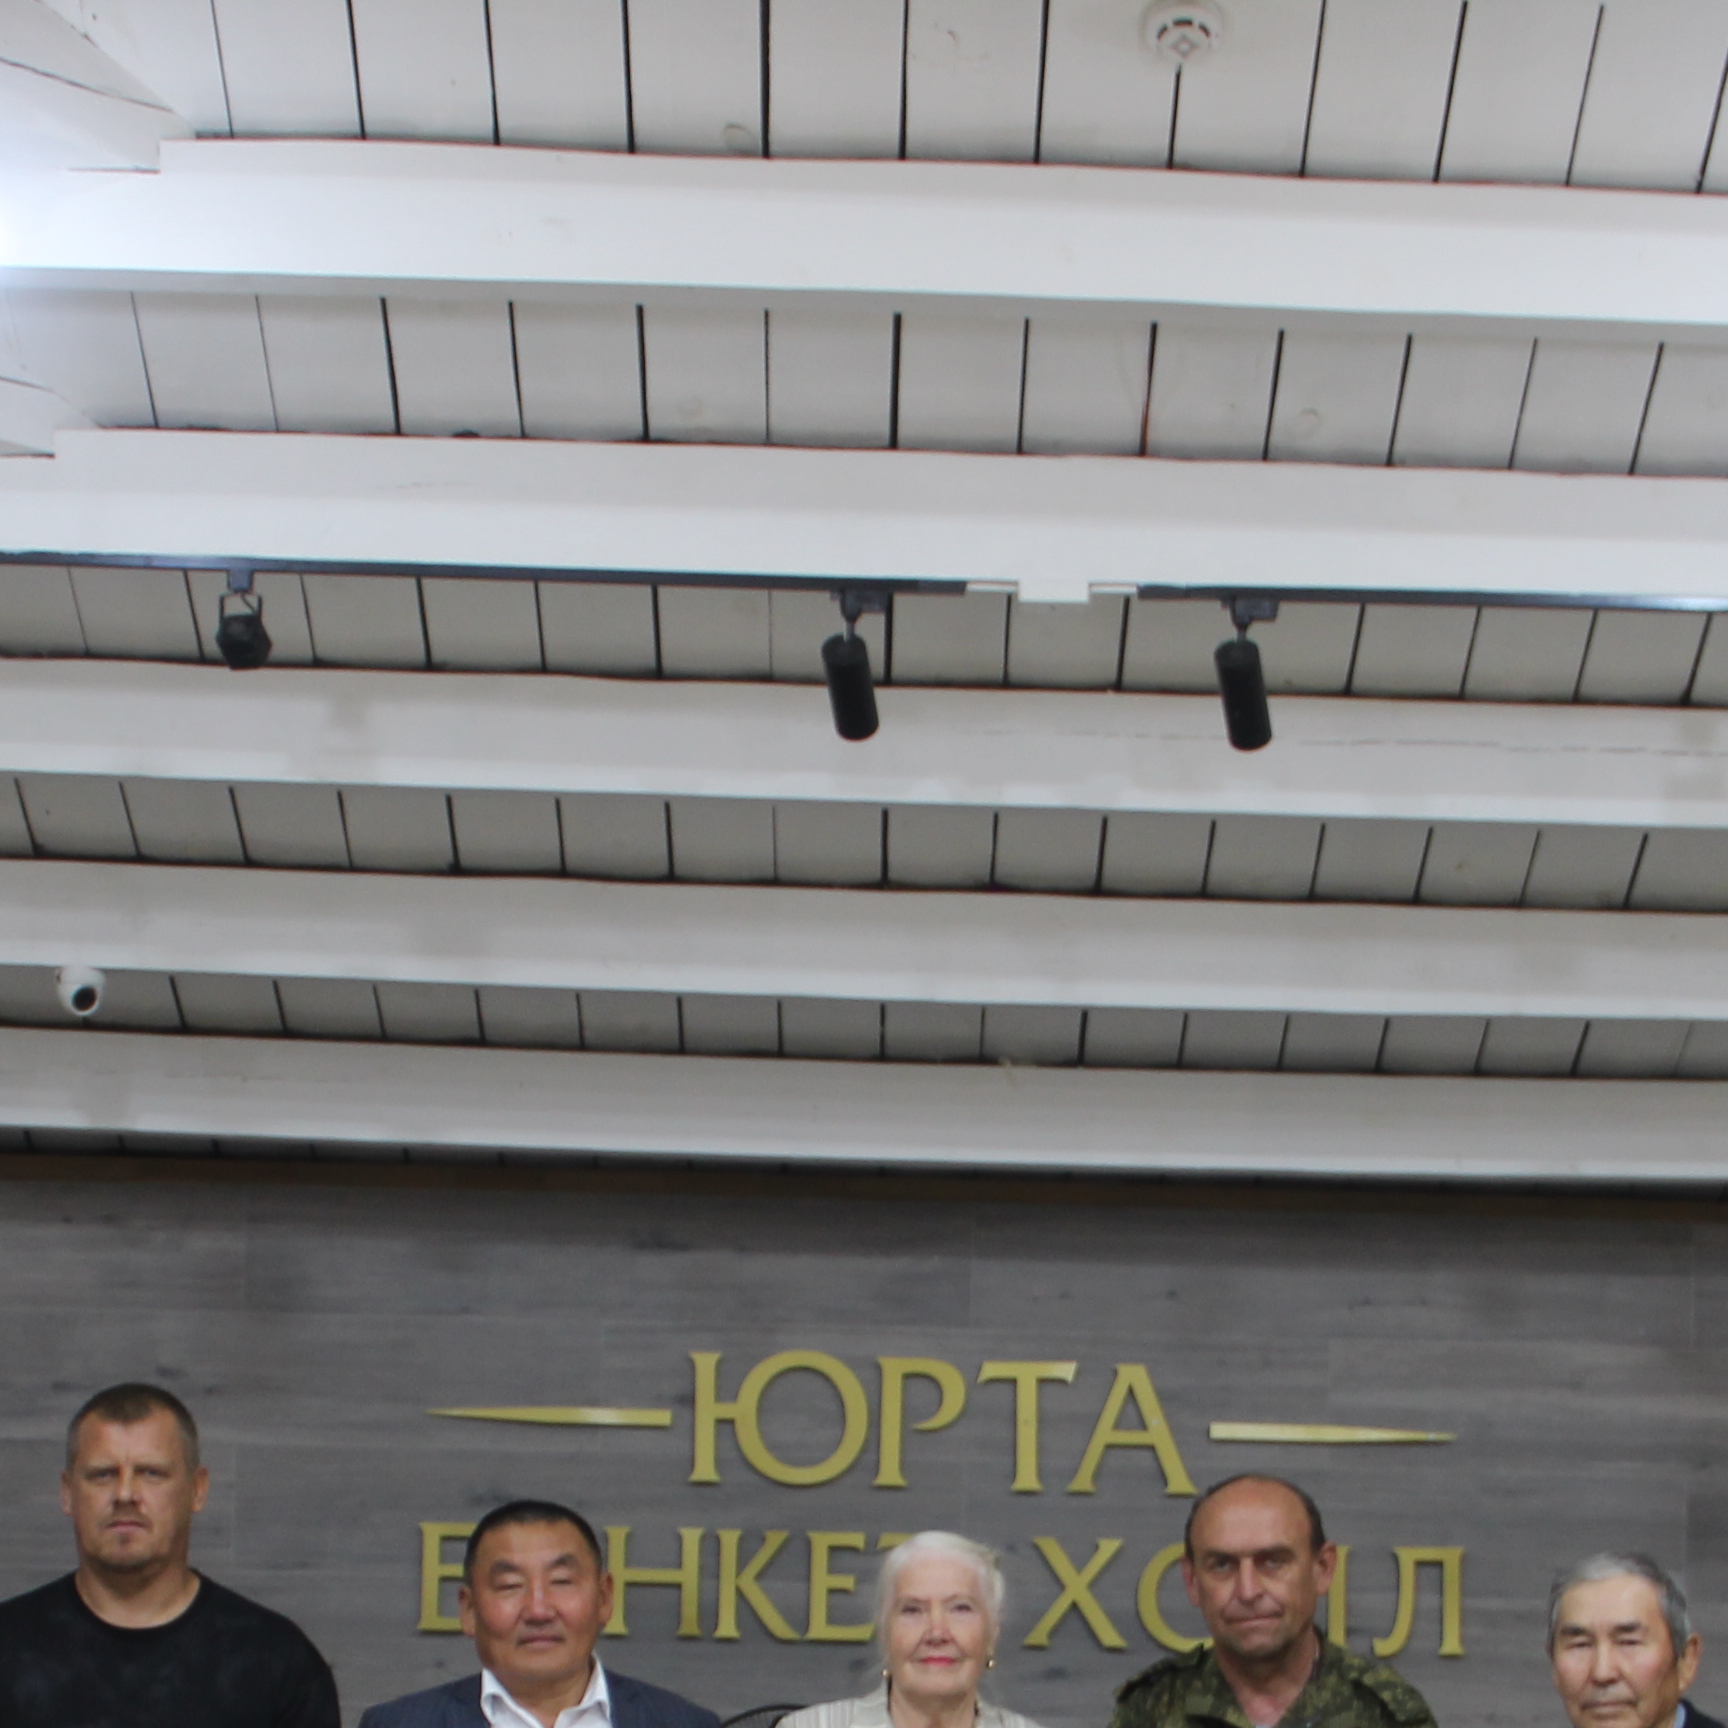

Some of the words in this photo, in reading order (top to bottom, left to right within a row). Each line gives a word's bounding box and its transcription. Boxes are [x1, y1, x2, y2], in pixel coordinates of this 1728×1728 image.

[688, 1350, 1199, 1495] ЮРТА
[417, 1521, 920, 1642] БНКЕ
[1022, 1536, 1466, 1657] ХОЛ
